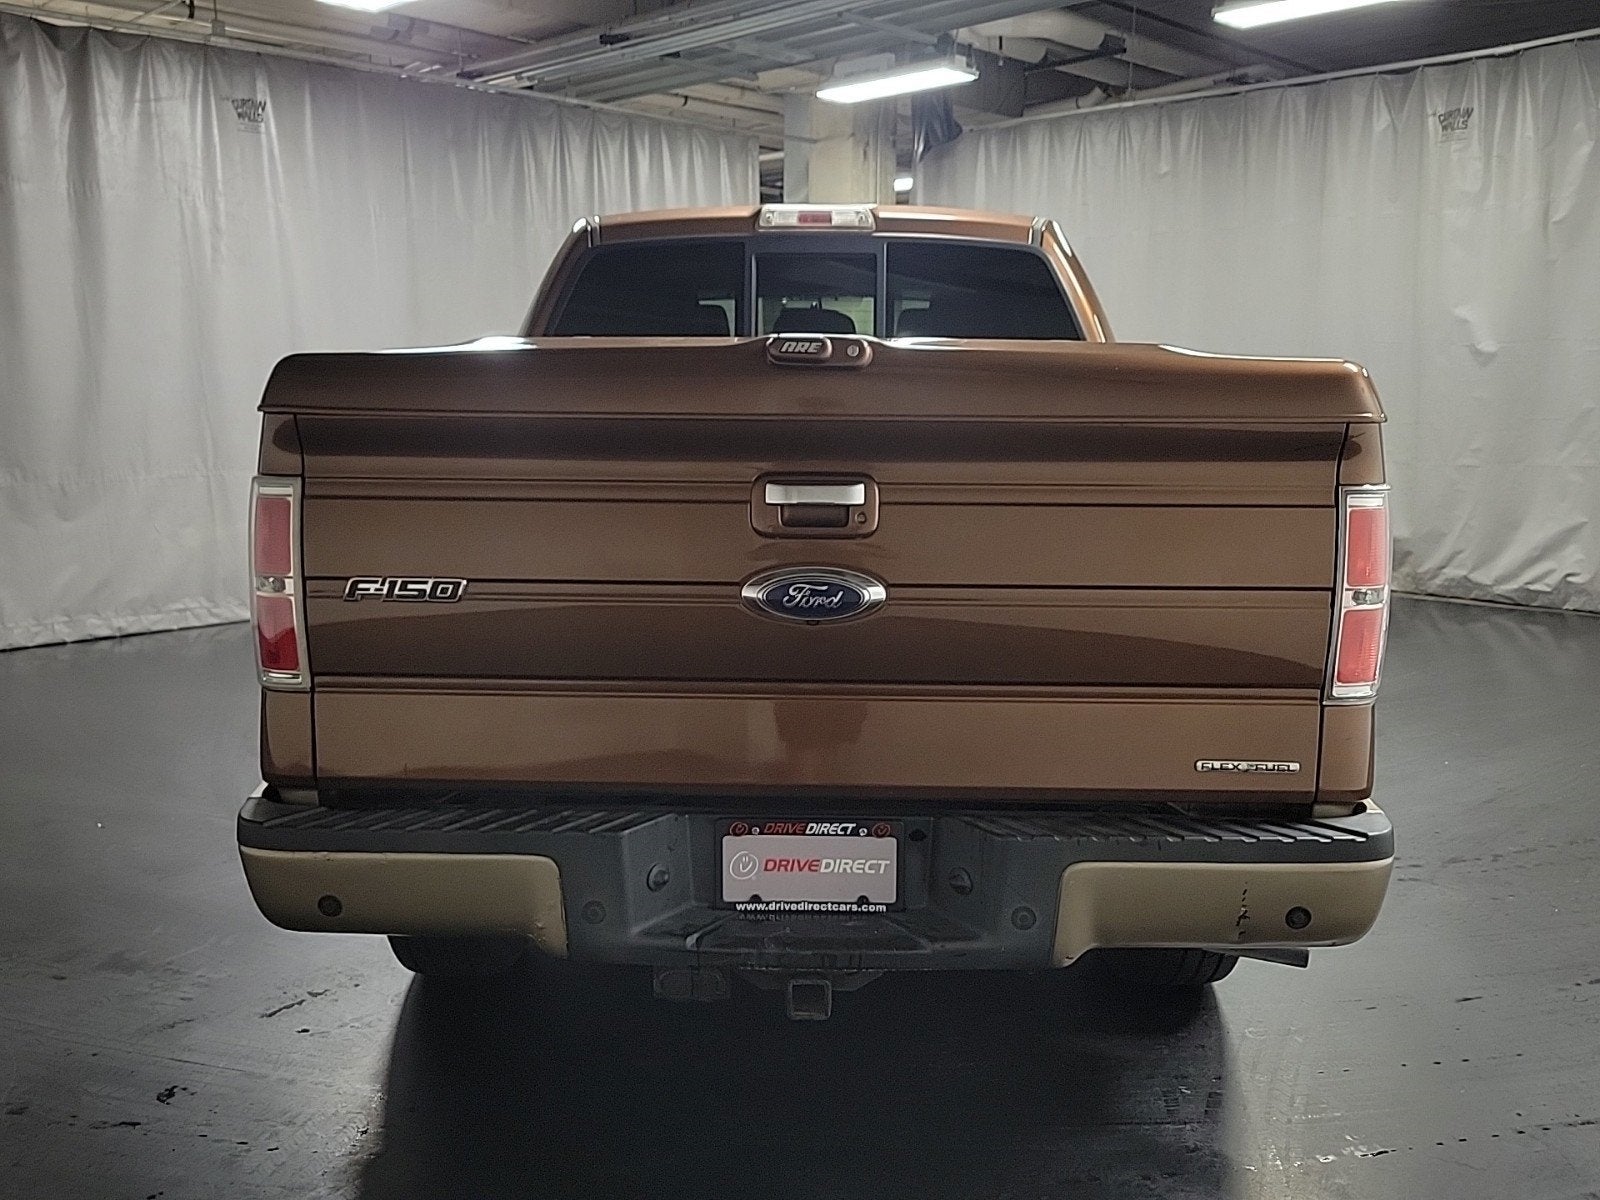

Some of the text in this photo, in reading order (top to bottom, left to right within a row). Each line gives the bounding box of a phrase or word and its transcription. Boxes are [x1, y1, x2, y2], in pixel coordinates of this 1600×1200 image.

[780, 341, 823, 353] ARE
[343, 577, 467, 602] F-150
[782, 583, 844, 608] Ford
[1201, 762, 1298, 773] FLEX FUEL
[735, 901, 887, 912] www.drivedirectcars.com
